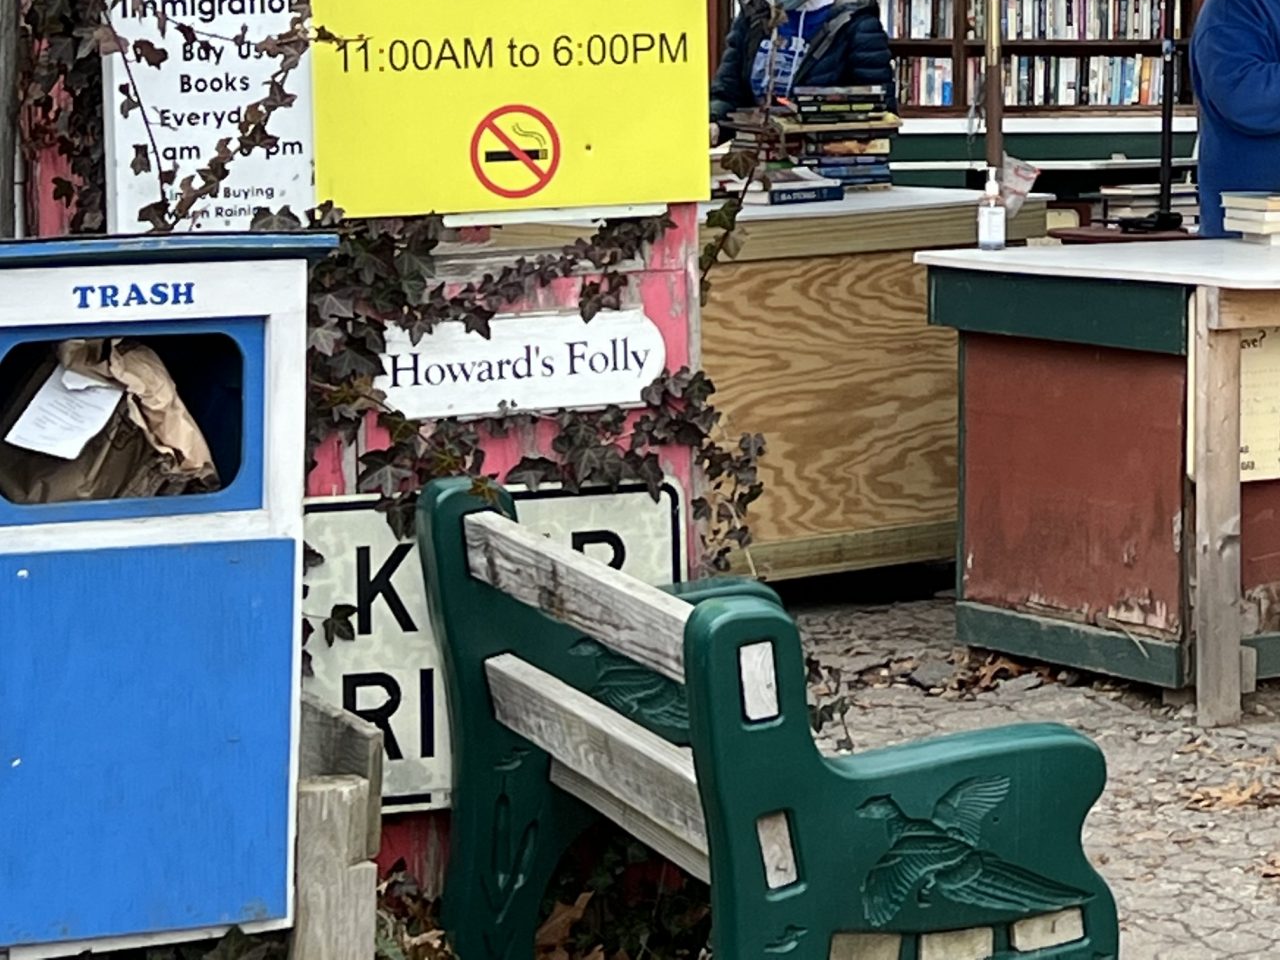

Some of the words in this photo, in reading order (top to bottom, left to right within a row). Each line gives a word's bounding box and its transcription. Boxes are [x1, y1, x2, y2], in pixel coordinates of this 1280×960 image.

[334, 36, 495, 74] 11:00AM
[507, 39, 541, 68] to
[552, 31, 689, 69] 6:00PM
[179, 72, 251, 94] Books
[159, 105, 242, 130] Everyd
[161, 144, 201, 161] am
[223, 186, 275, 200] Buying
[73, 281, 196, 309] TRASH
[388, 345, 556, 390] Howard's
[564, 334, 651, 379] Folly
